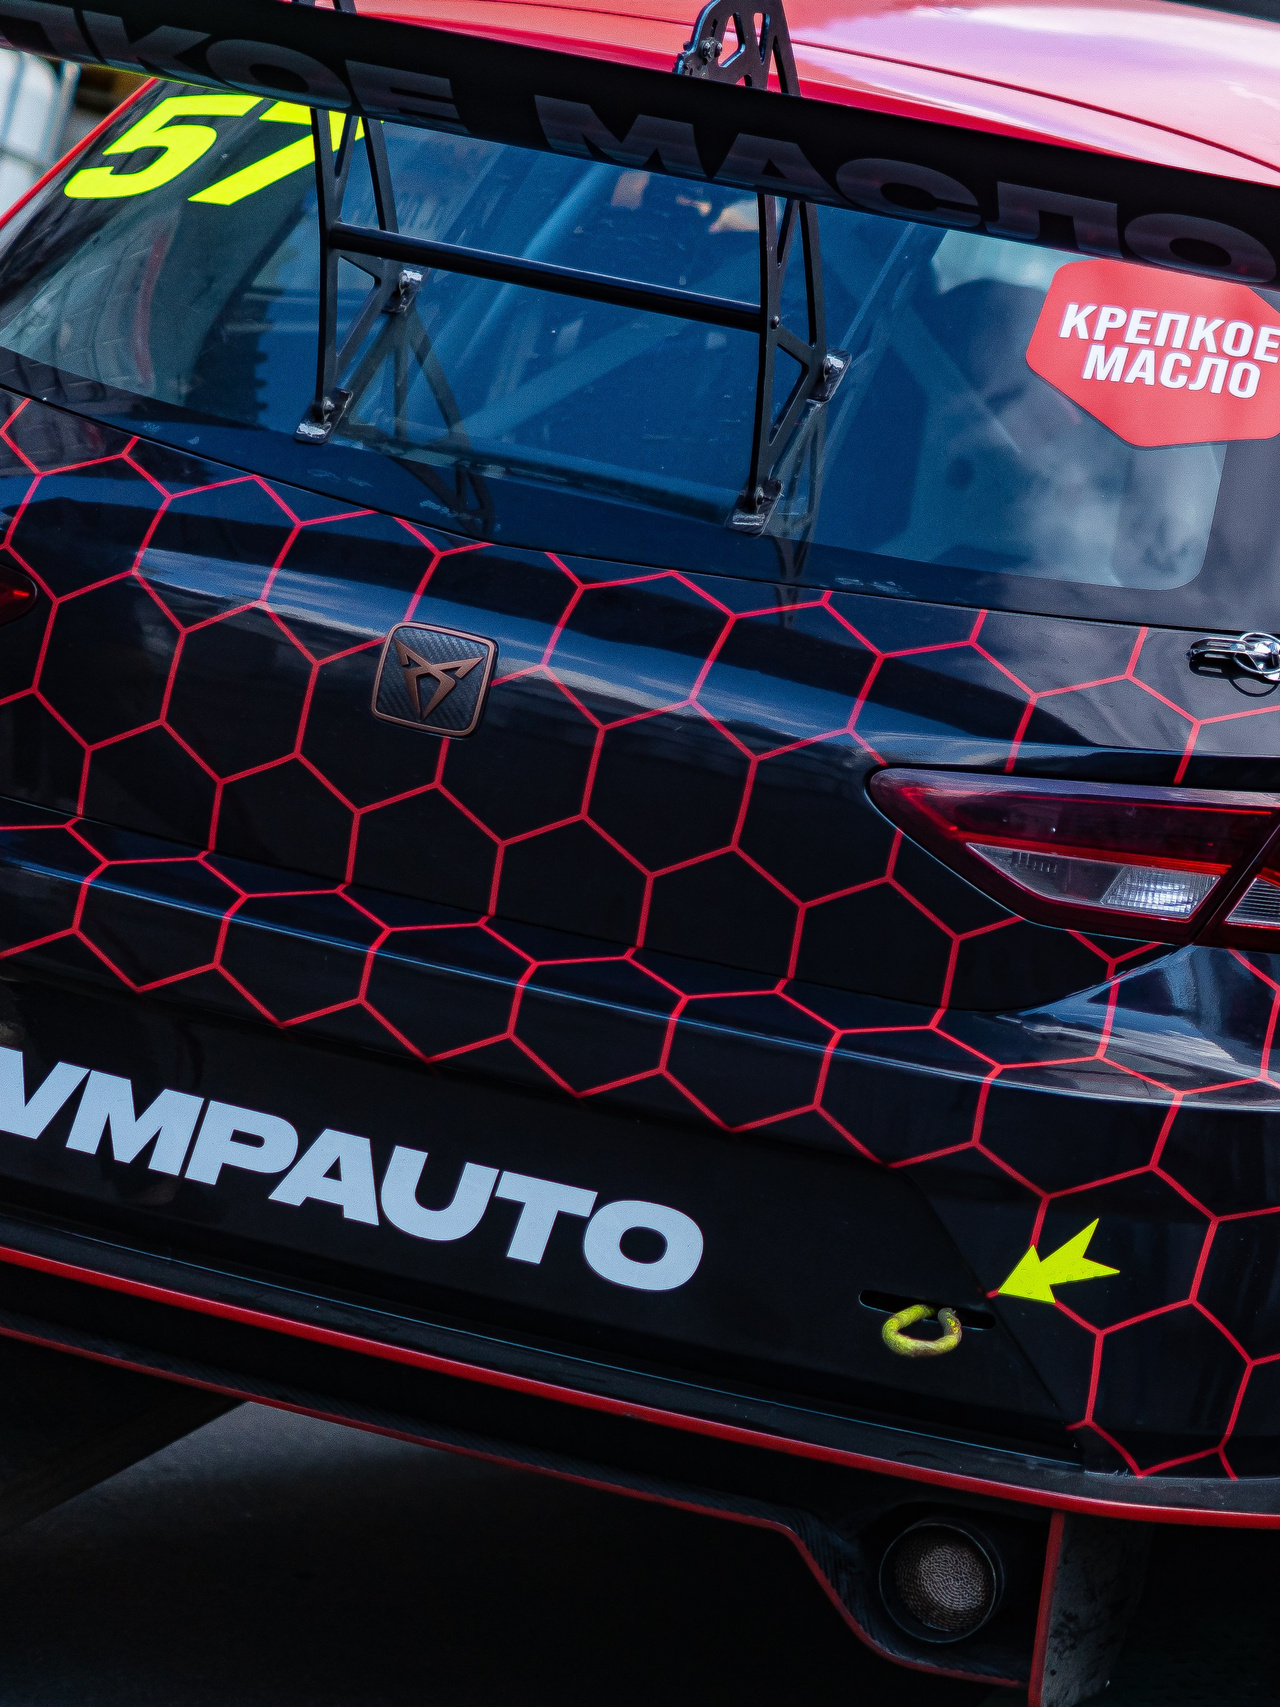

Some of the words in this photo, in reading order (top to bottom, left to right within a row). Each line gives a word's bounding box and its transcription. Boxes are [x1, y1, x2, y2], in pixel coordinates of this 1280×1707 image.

[63, 94, 384, 206] 57
[533, 94, 1277, 283] МАСЛО
[1082, 345, 1261, 399] МАСЛО
[0, 1047, 704, 1292] VMPAUTO
